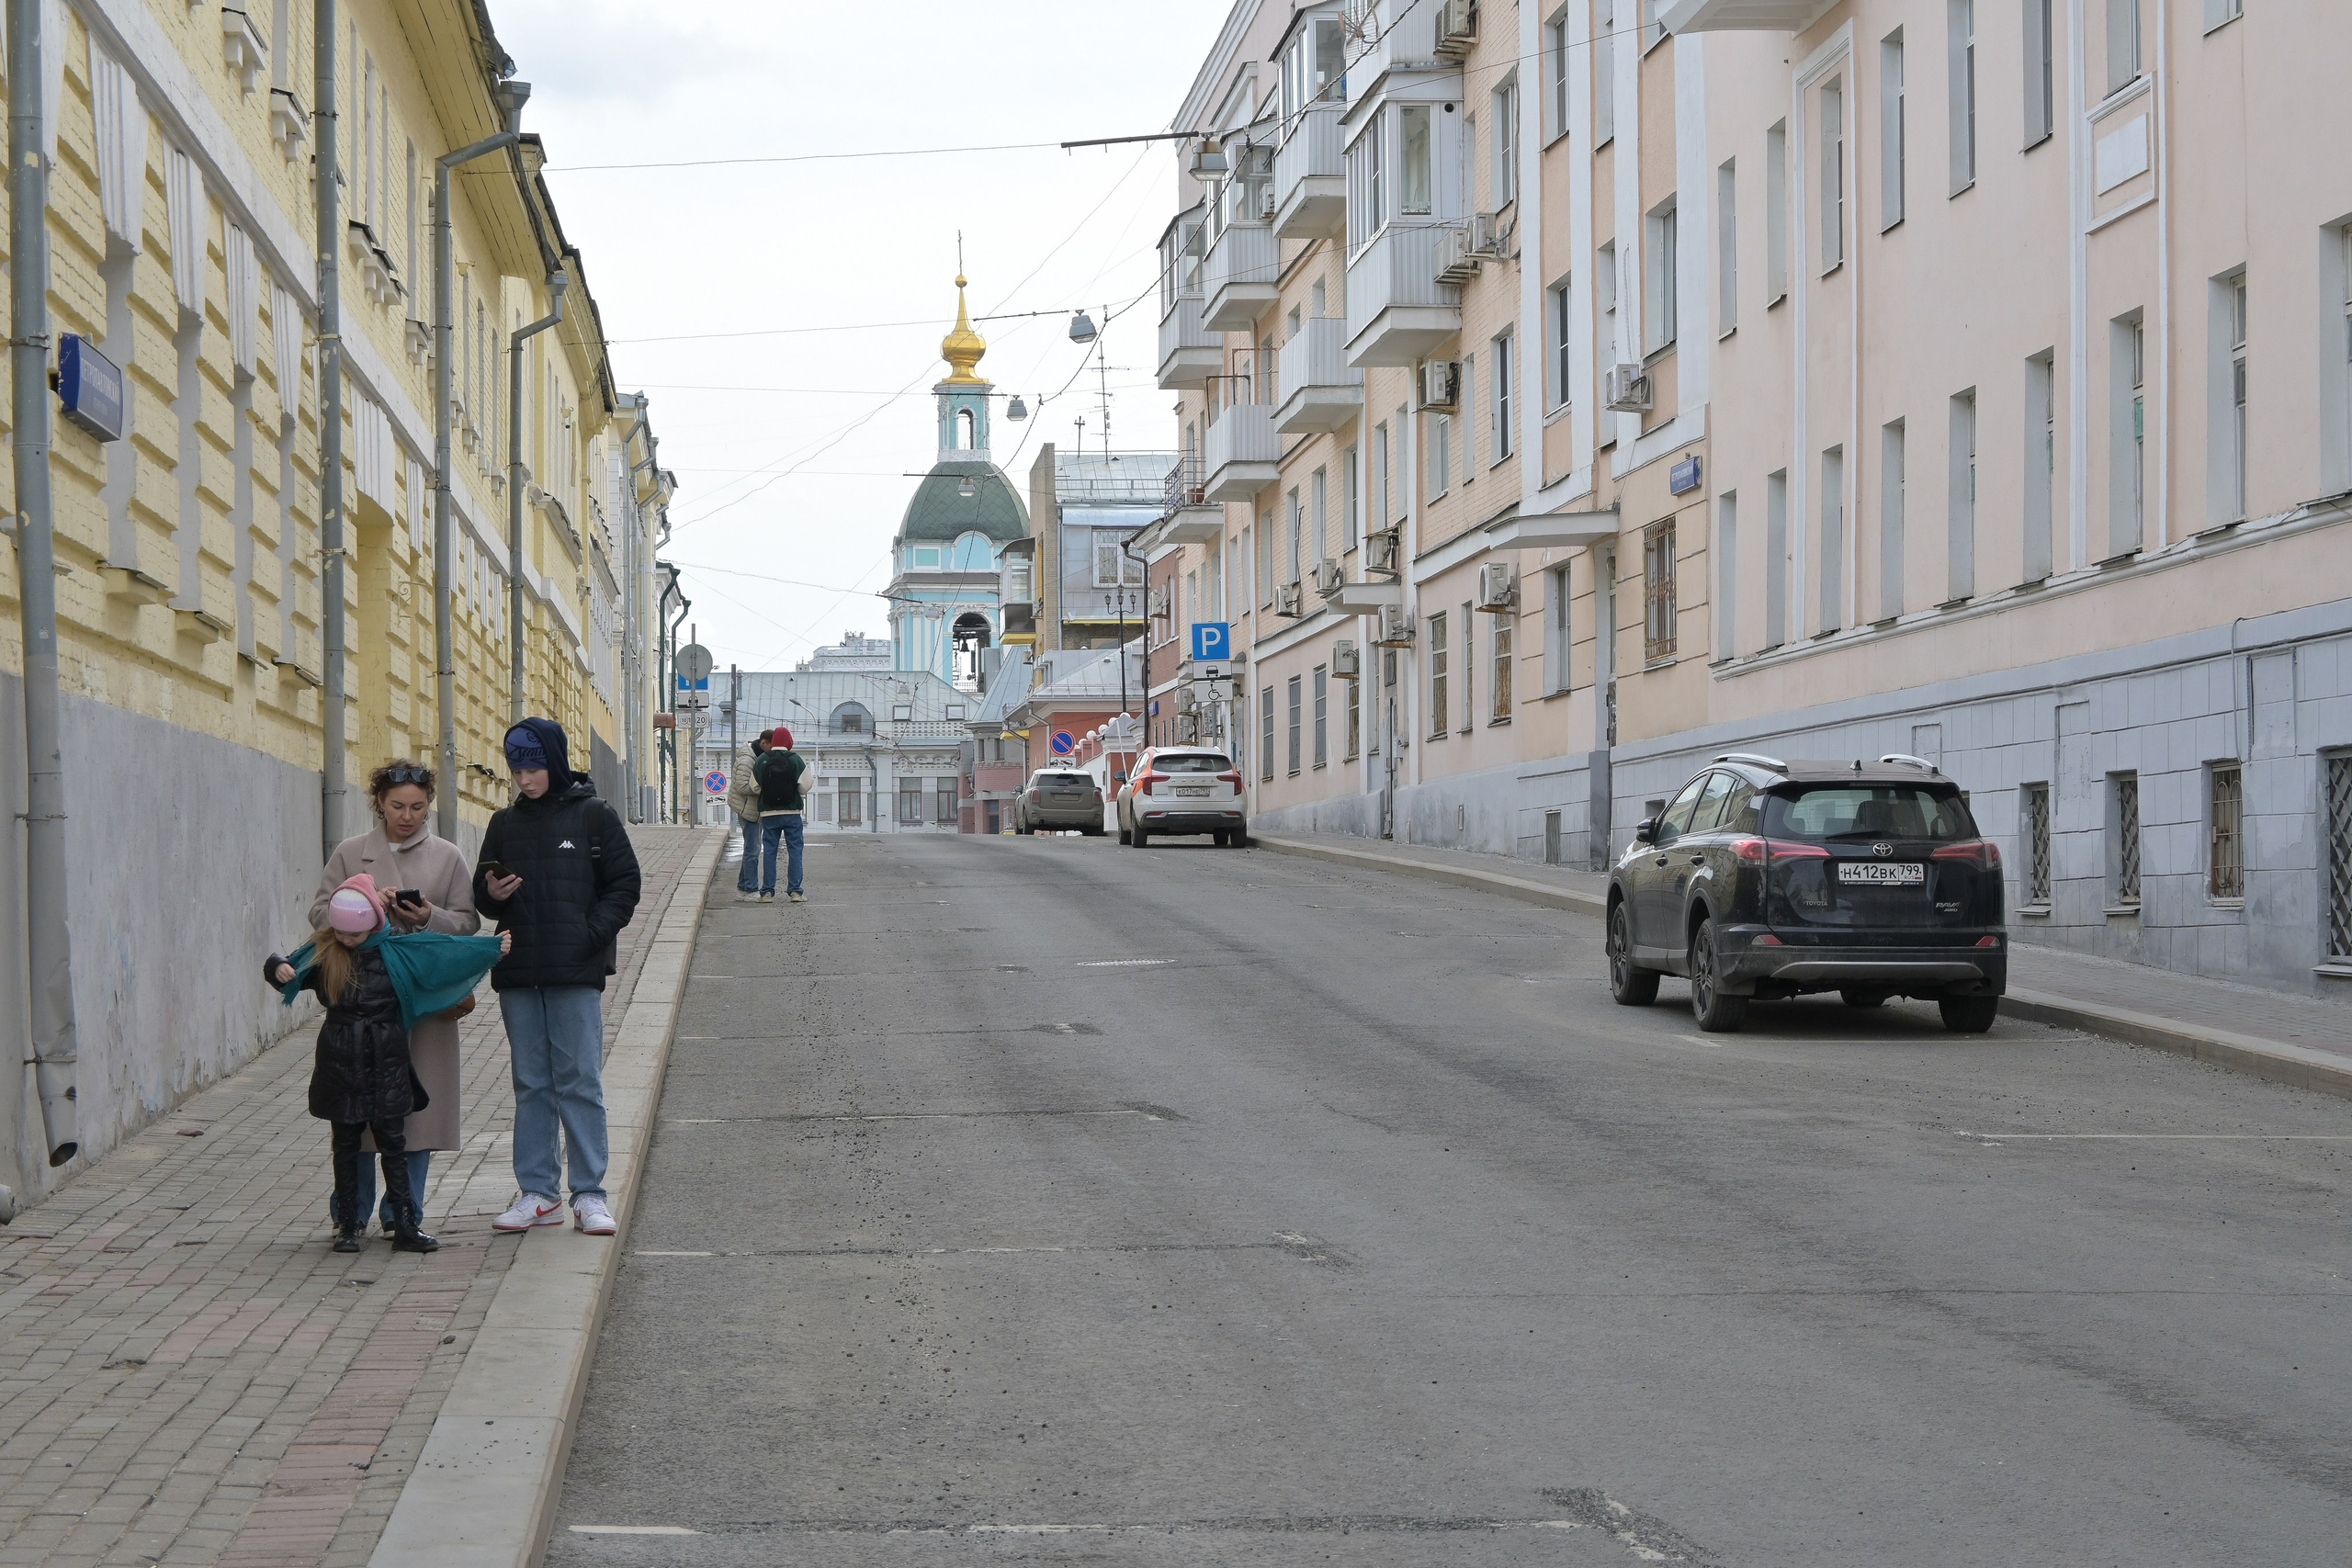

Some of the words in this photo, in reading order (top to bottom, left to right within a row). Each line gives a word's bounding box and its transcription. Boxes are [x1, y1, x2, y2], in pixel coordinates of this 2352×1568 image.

[1201, 627, 1221, 656] P
[1843, 865, 1897, 879] Н412ВК
[1899, 865, 1920, 875] 799
